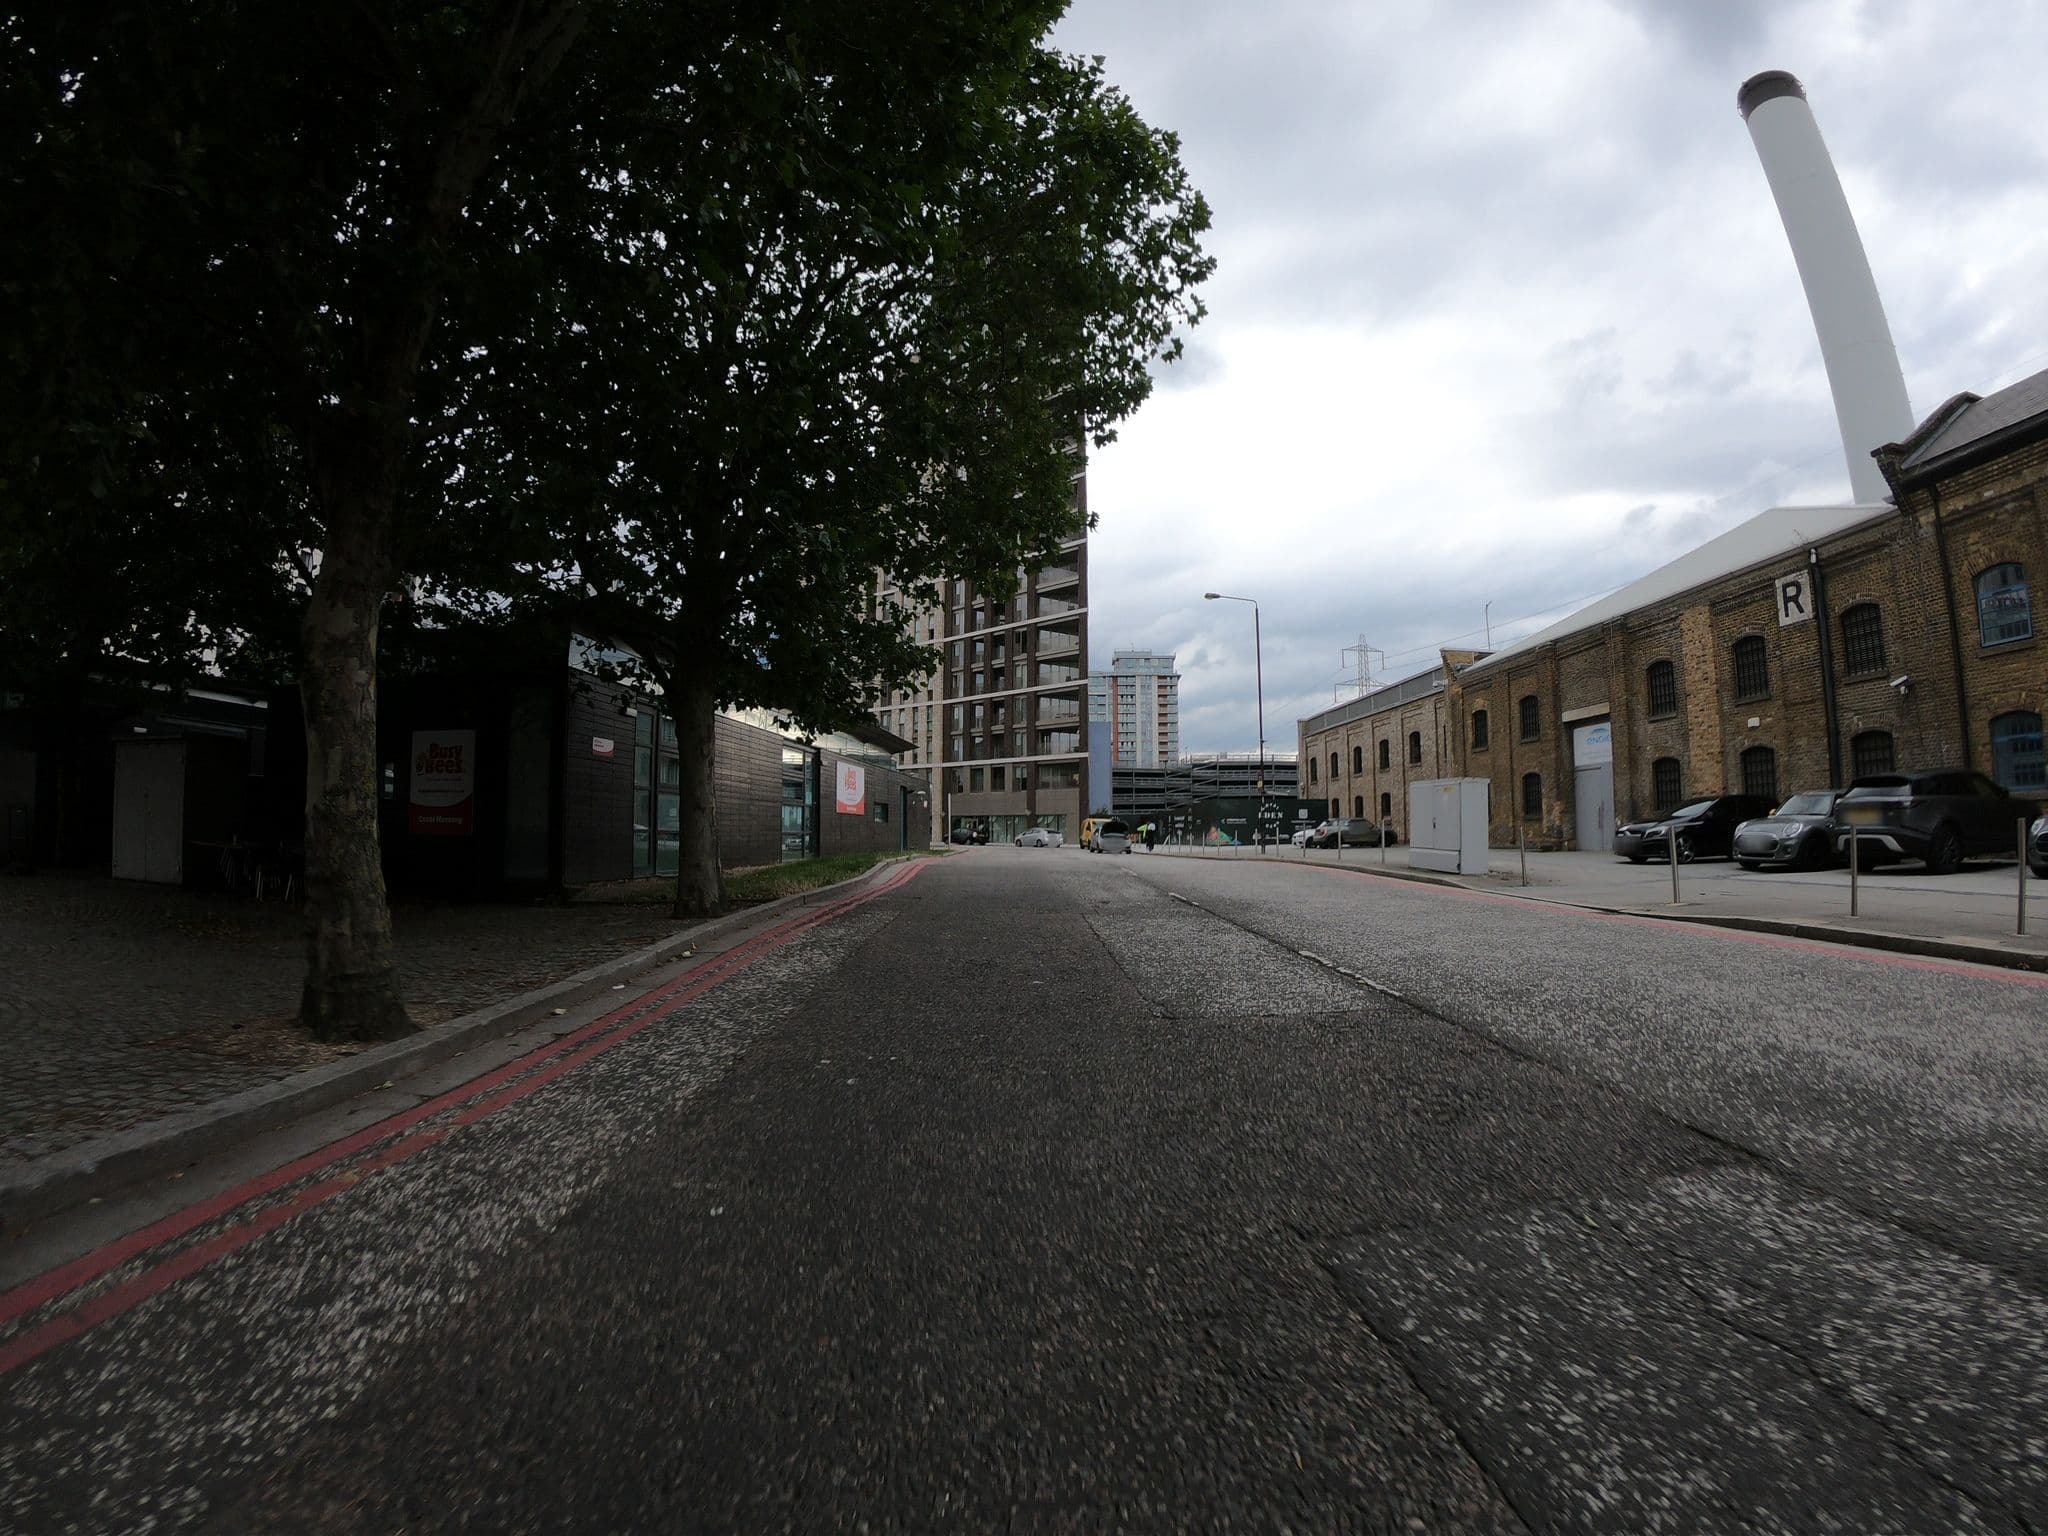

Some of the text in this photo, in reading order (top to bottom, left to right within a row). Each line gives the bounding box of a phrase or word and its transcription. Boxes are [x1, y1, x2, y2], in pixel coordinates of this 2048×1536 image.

[1782, 580, 1805, 618] R
[430, 742, 463, 761] Busy
[425, 759, 464, 775] Bees
